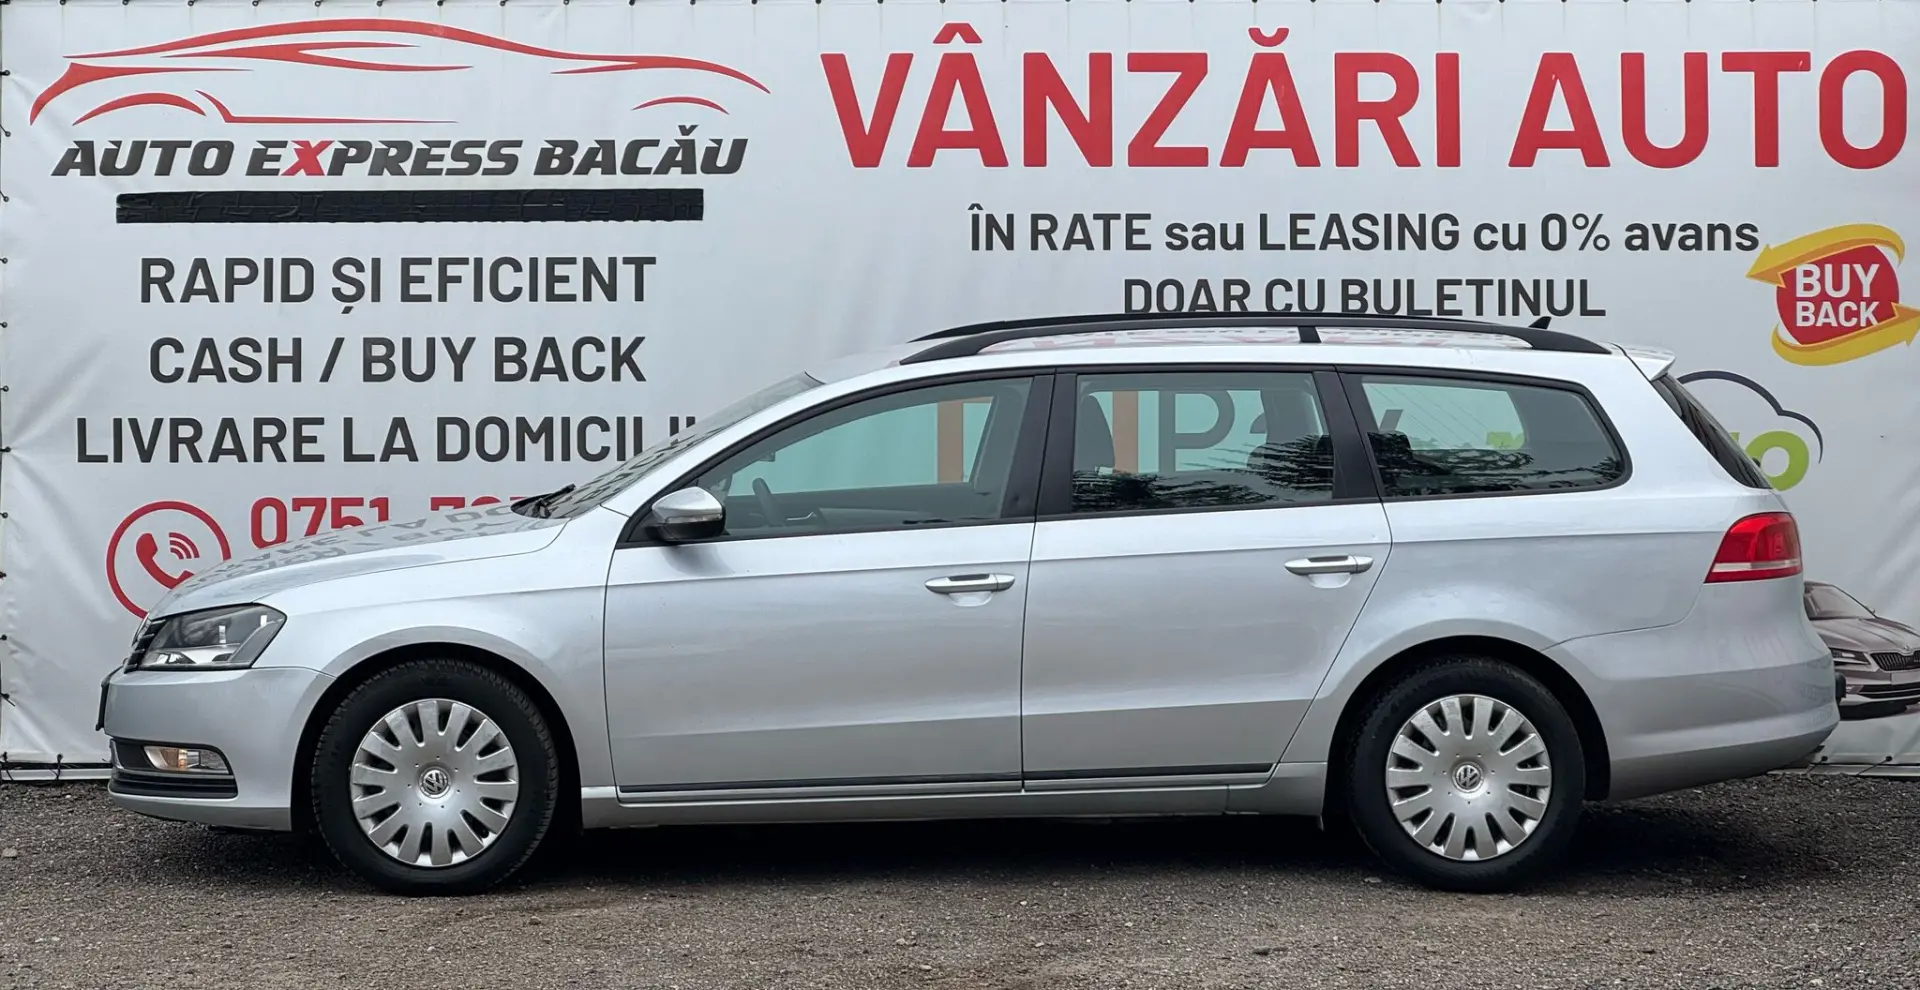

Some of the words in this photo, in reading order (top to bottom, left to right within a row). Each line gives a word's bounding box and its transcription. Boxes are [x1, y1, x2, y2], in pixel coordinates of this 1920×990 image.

[820, 22, 1461, 168] VÂNZĂRI
[1508, 49, 1907, 169] AUTO
[51, 140, 235, 177] AUTO
[245, 139, 523, 177] EXPRESS
[533, 124, 749, 176] BACĂU
[967, 203, 1015, 251] ÎN
[1030, 213, 1152, 251] RATE
[1165, 222, 1244, 251] sau
[1259, 212, 1460, 251] LEASING
[1473, 222, 1526, 251] cu
[1541, 213, 1610, 252] 0%
[1624, 222, 1759, 252] avans
[141, 257, 315, 303] RAPID
[331, 257, 381, 315] ȘI
[400, 256, 657, 303] EFICIENT
[1124, 278, 1251, 313] DOAR
[1265, 278, 1326, 313] CU
[1341, 278, 1606, 317] BULETINUL
[1795, 263, 1880, 298] BUY
[1796, 301, 1880, 327] BACK
[150, 337, 302, 384] CASH
[362, 336, 476, 383] BUY
[494, 336, 647, 383] BACK
[77, 417, 325, 464] LIVRARE
[343, 416, 419, 463] LA
